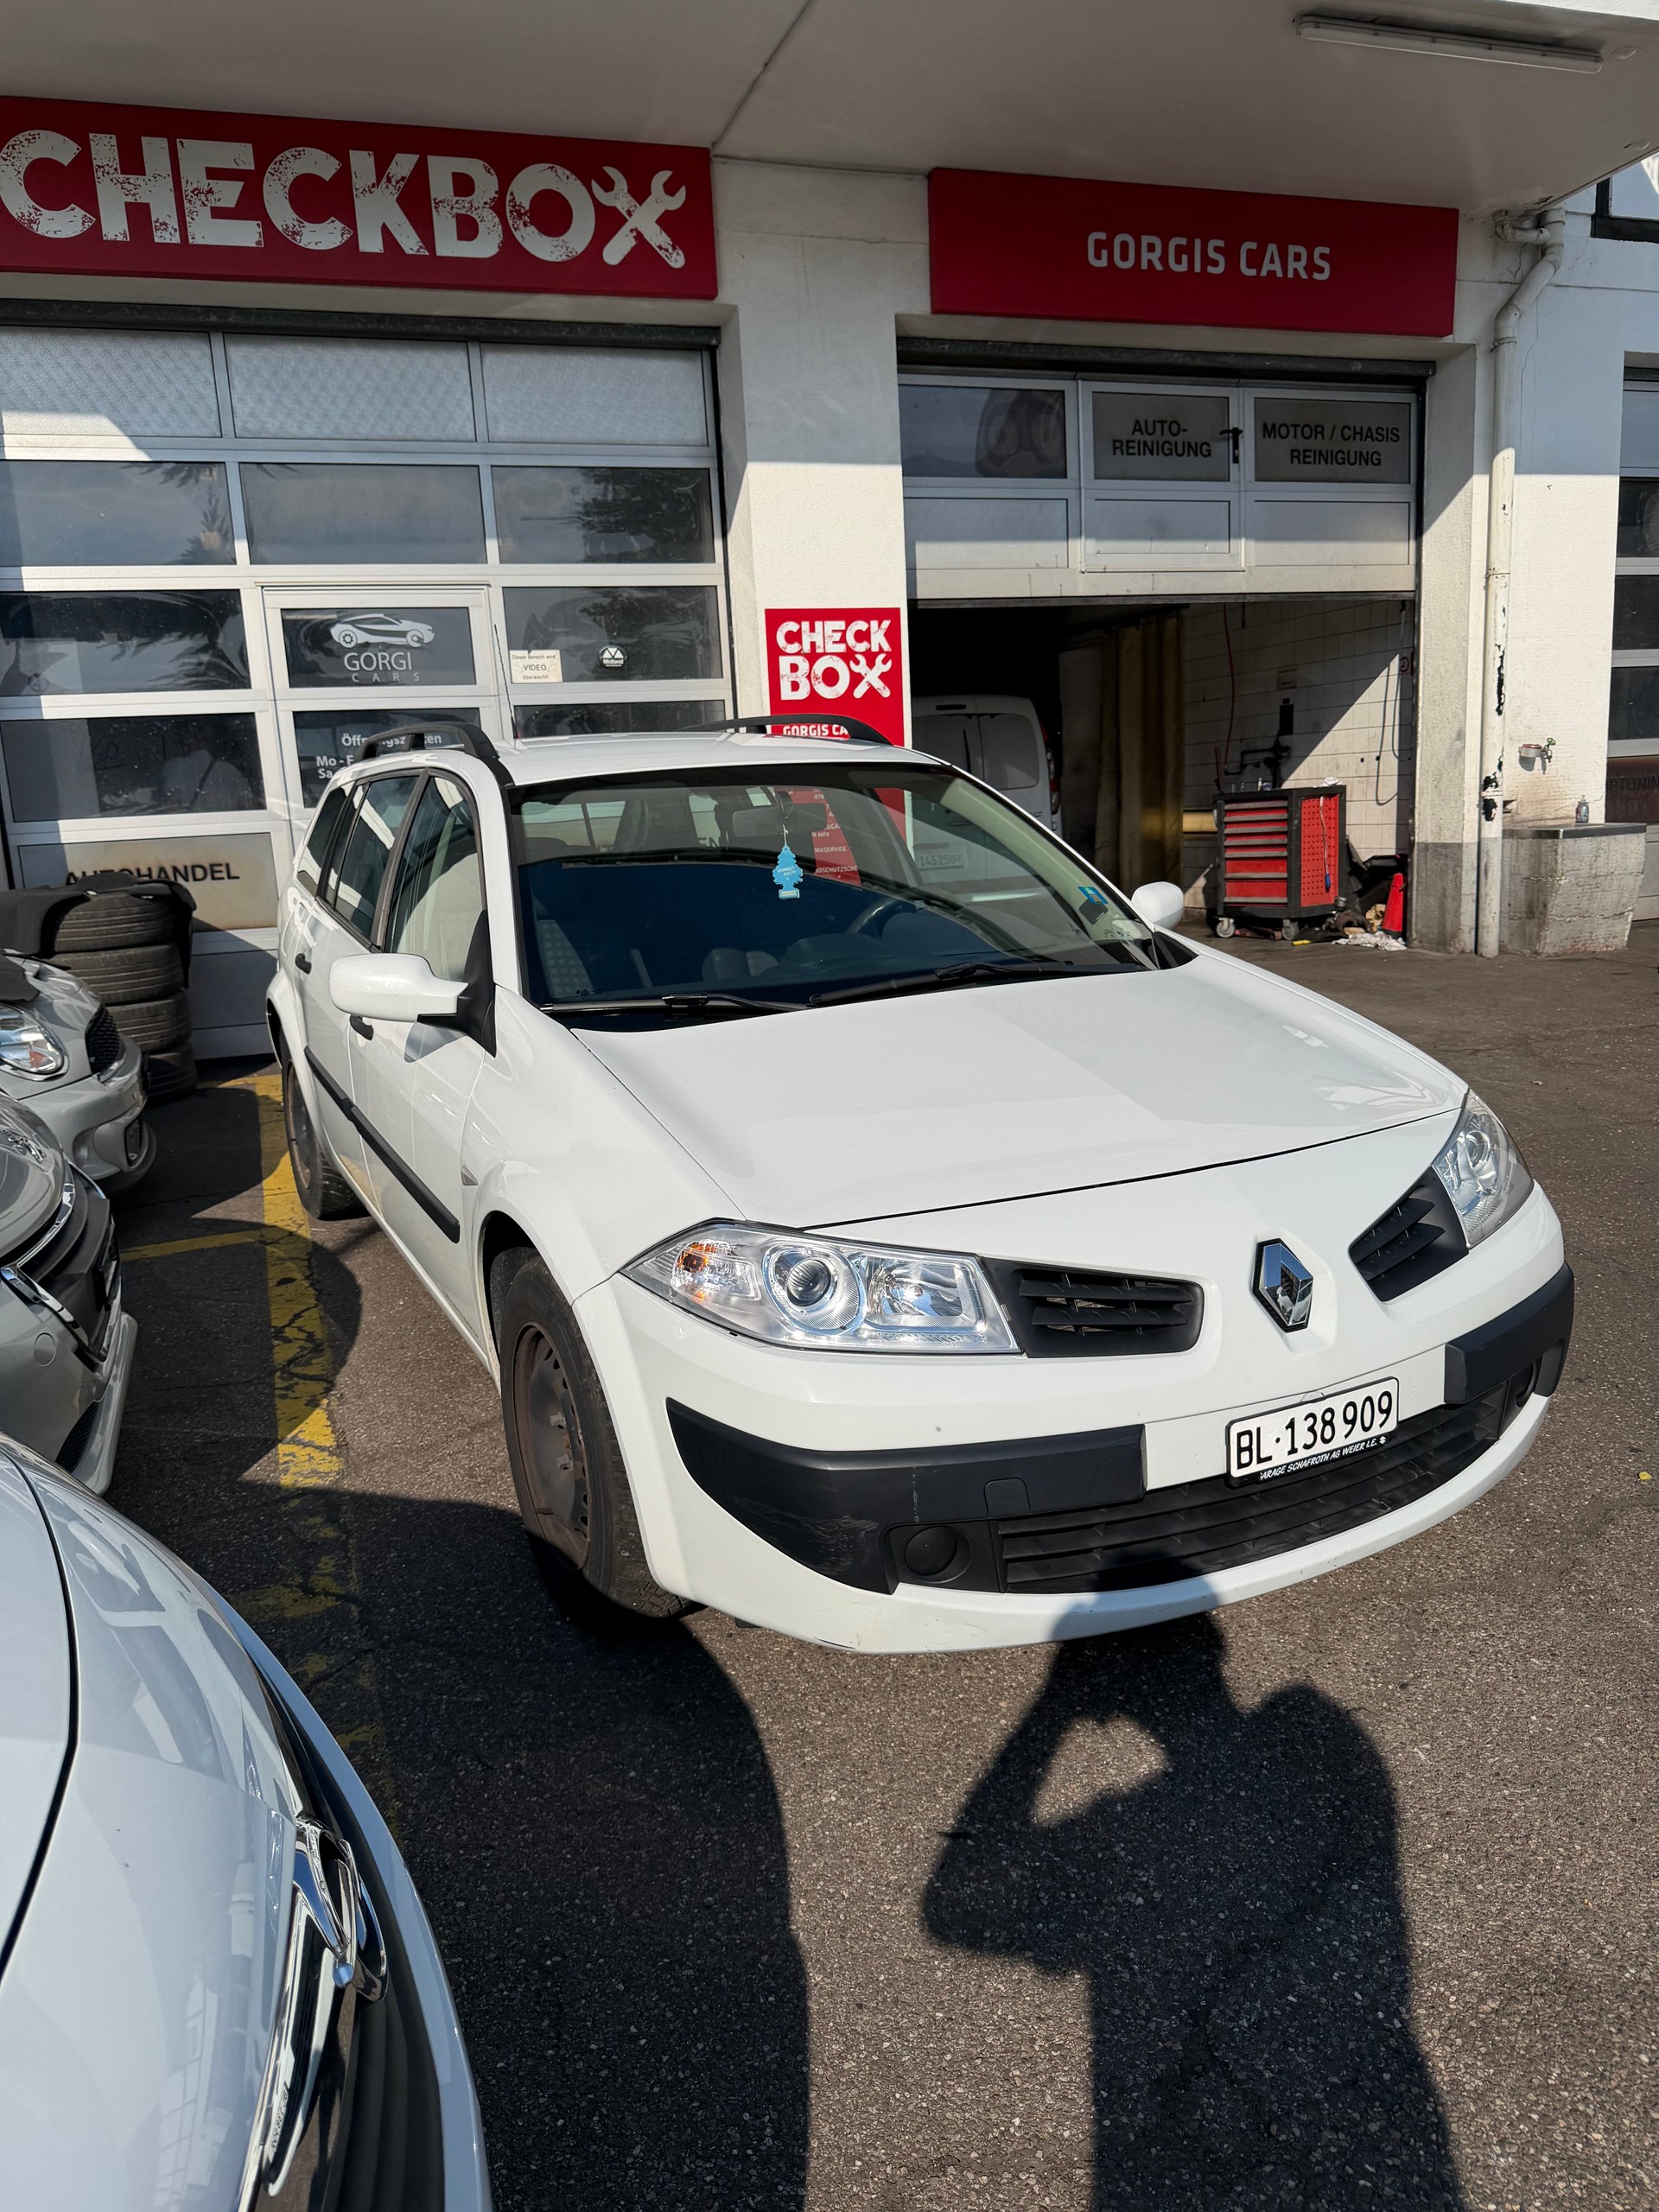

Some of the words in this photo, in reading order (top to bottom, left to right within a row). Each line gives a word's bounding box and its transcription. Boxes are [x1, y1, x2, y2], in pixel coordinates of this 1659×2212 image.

[1087, 231, 1226, 275] GORGIS
[1239, 241, 1332, 281] CARS
[1131, 419, 1188, 436] AUTO-
[1262, 423, 1326, 441] MOTOR
[1340, 424, 1401, 442] CHASIS
[1112, 439, 1212, 458] REINIGUNG
[1289, 448, 1382, 467] REINIGUNG
[776, 620, 893, 654] CHECK
[344, 652, 413, 672] GORGI
[351, 672, 421, 683] CARS
[782, 723, 830, 736] GORGIS
[832, 724, 849, 735] CA
[316, 755, 337, 767] Mo
[318, 768, 334, 779] Sa
[814, 845, 847, 854] MASERVICE
[66, 862, 241, 887] AHANDEL
[1287, 1452, 1331, 1472] SCHAFROTH
[1330, 1449, 1340, 1460] AG
[1342, 1442, 1365, 1456] WEIER
